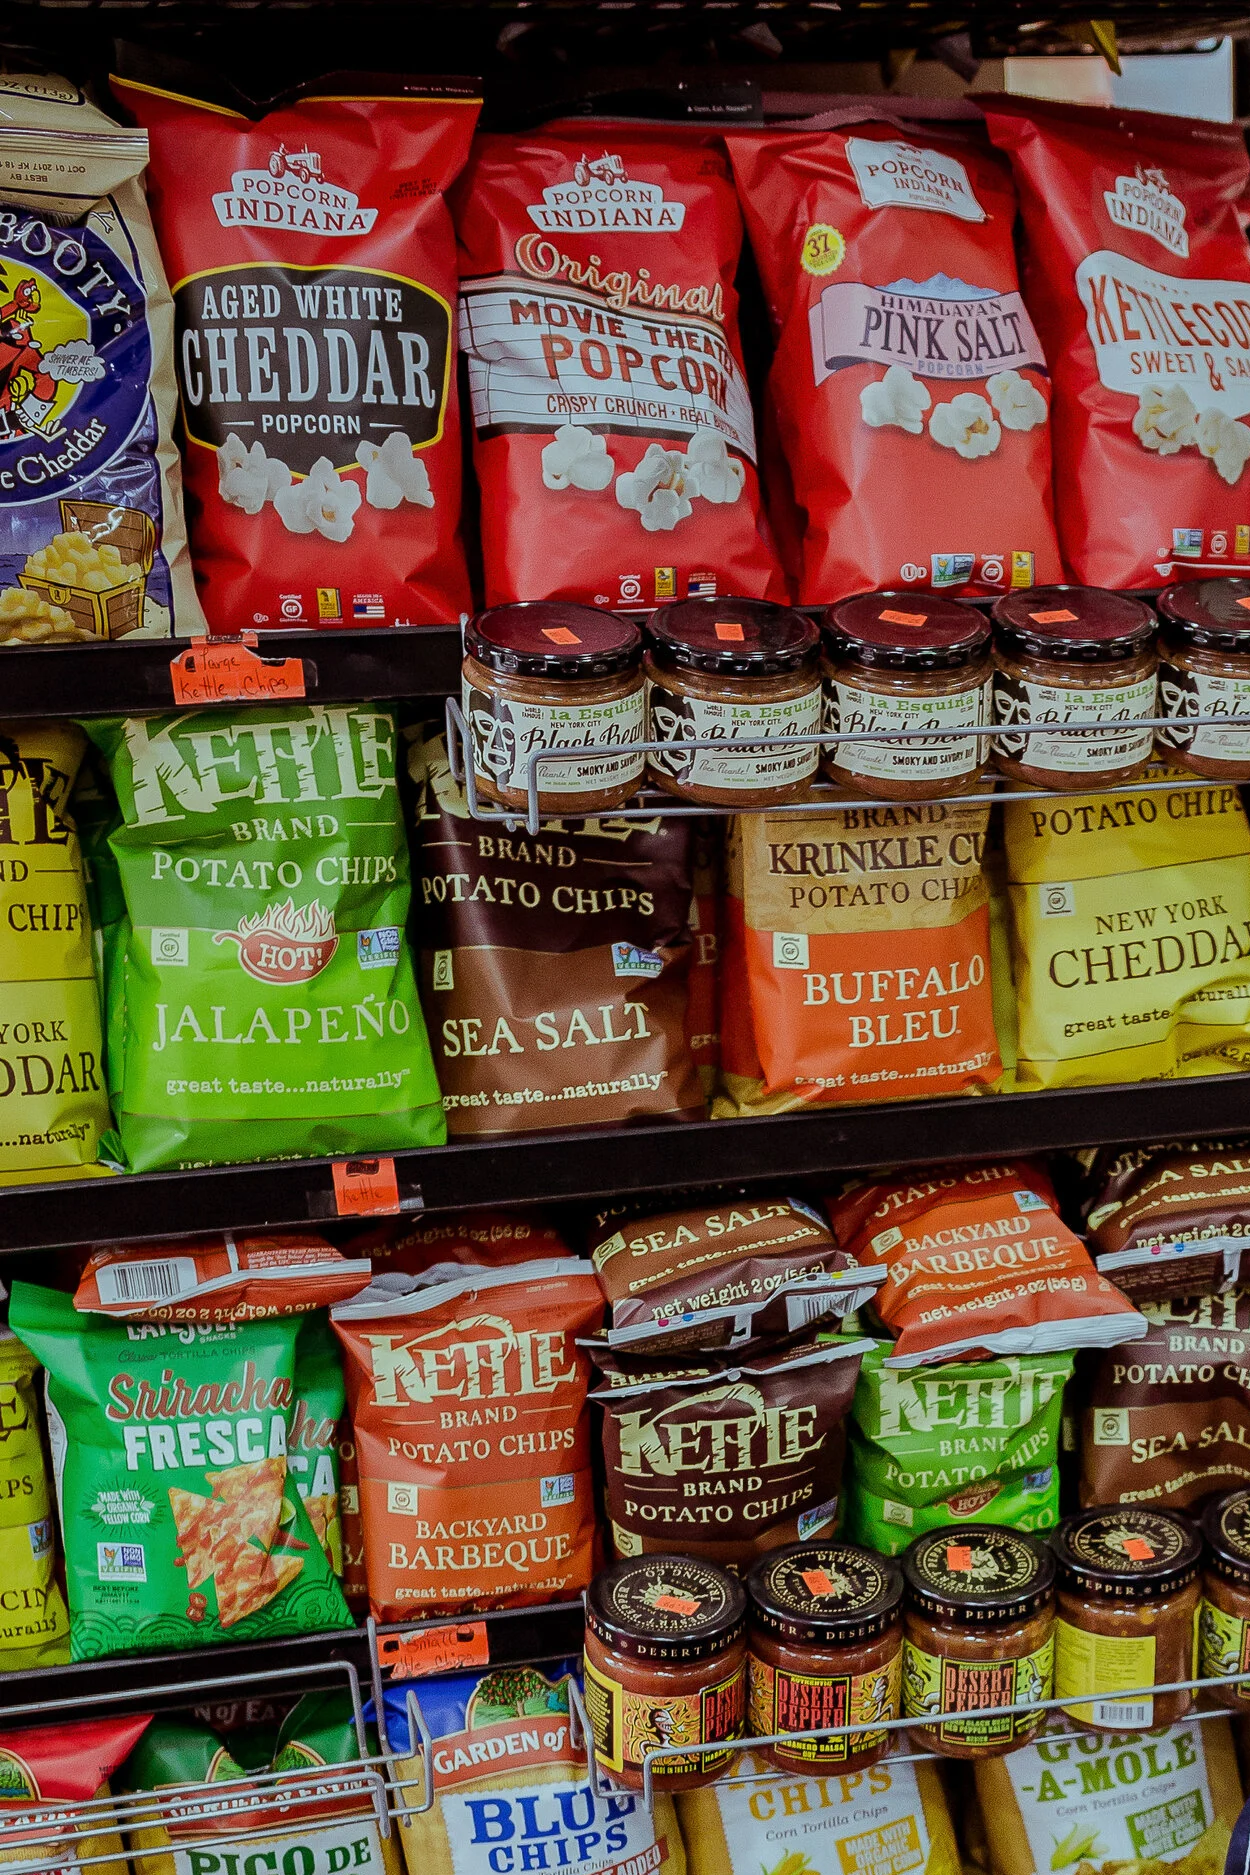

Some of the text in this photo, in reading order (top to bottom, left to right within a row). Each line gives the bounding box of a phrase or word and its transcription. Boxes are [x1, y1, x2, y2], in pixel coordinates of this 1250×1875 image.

[10, 173, 23, 181] BY
[242, 177, 351, 210] POPCORN
[867, 160, 966, 195] POPCORN
[552, 188, 654, 206] POPCORN
[224, 199, 367, 231] INDIANA
[538, 207, 677, 227] INDIANA
[807, 233, 831, 256] 37
[0, 212, 131, 315] BOOTY
[514, 232, 726, 322] Original
[201, 284, 403, 324] AGED WHITE
[880, 295, 1003, 317] HIMALAYAN
[860, 305, 1028, 362] PINK SALT
[49, 353, 92, 365] SHIVER ME
[56, 366, 99, 377] TIMBERS!
[181, 327, 436, 409] CHEDDAR
[540, 333, 729, 415] POPCORN
[918, 359, 985, 376] POPCORN
[261, 413, 362, 435] POPCORN
[17, 418, 108, 485] Cheddar
[199, 648, 241, 672] Large
[179, 669, 289, 699] Kettle Chips
[550, 709, 570, 720] la
[550, 719, 603, 729] NEW YORK CITY
[520, 719, 644, 753] Black Bean
[121, 706, 397, 829] KETTLE
[577, 763, 605, 778] SMOKY
[605, 761, 619, 775] AND
[231, 814, 339, 842] BRAND
[1031, 797, 1158, 838] POTATO
[478, 836, 577, 867] BRAND
[151, 852, 397, 890] POTATO CHIPS
[422, 872, 655, 916] POTATO CHIPS
[1095, 894, 1229, 936] NEW YORK
[260, 941, 324, 971] HOT!
[802, 953, 985, 1007] BUFFALO
[152, 994, 411, 1051] JALAPEÑO
[442, 1000, 654, 1058] SEA SALT
[848, 1004, 960, 1049] BLEU
[1063, 1006, 1171, 1038] great taste
[342, 1177, 385, 1205] Kettle
[629, 1204, 791, 1259] SEA SALT
[904, 1214, 1032, 1254] BACKYARD
[889, 1235, 1068, 1289] BARBEQUE
[360, 1313, 577, 1408] KETTLE
[1169, 1335, 1246, 1356] BRAND
[105, 1360, 294, 1422] Sriracha
[869, 1356, 1073, 1442] KETTLE
[440, 1404, 518, 1431] BRAND
[611, 1382, 828, 1478] KETTLE
[123, 1415, 288, 1472] FRESCA
[388, 1427, 576, 1465] POTATO CHIPS
[1131, 1433, 1189, 1465] SEA
[98, 1488, 141, 1503] MADE WITH
[624, 1482, 815, 1525] POTATO CHIPS
[684, 1476, 763, 1498] BRAND
[101, 1511, 151, 1526] YELLOW CORN
[106, 1501, 139, 1514] ORGANIC
[415, 1511, 548, 1541] BACKYARD
[388, 1532, 574, 1574] BARBEQUE
[826, 1620, 885, 1641] DESERT
[637, 1644, 703, 1658] DESERT
[778, 1678, 847, 1709] DESERT
[946, 1665, 1014, 1694] DESERT
[778, 1701, 846, 1731] PEPPER
[433, 1725, 568, 1776] GARDEN of
[1022, 1730, 1199, 1802] -A-MOLE
[748, 1763, 894, 1822] CHIPS
[465, 1778, 638, 1846] BLUE
[325, 1836, 372, 1874] DE
[488, 1822, 629, 1875] CHIPS
